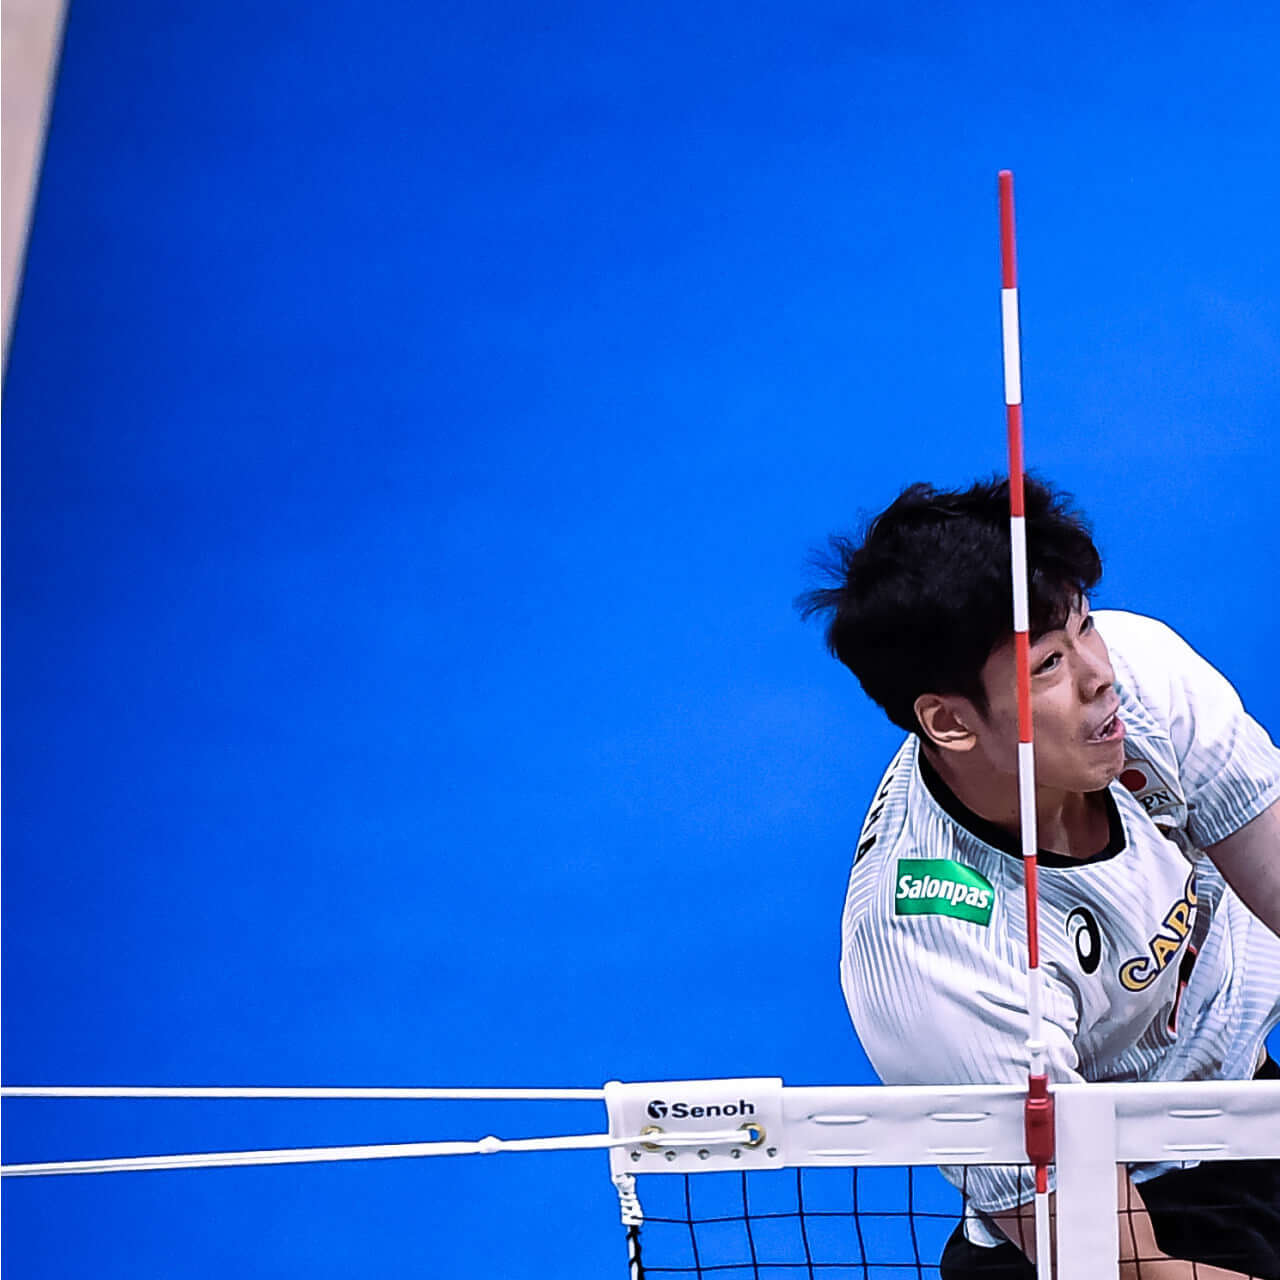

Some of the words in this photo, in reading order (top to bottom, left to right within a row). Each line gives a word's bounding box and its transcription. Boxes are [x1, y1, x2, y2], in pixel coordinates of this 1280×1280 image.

[1140, 789, 1172, 811] PN
[895, 874, 992, 910] Salonpas
[671, 1099, 755, 1119] Senoh
